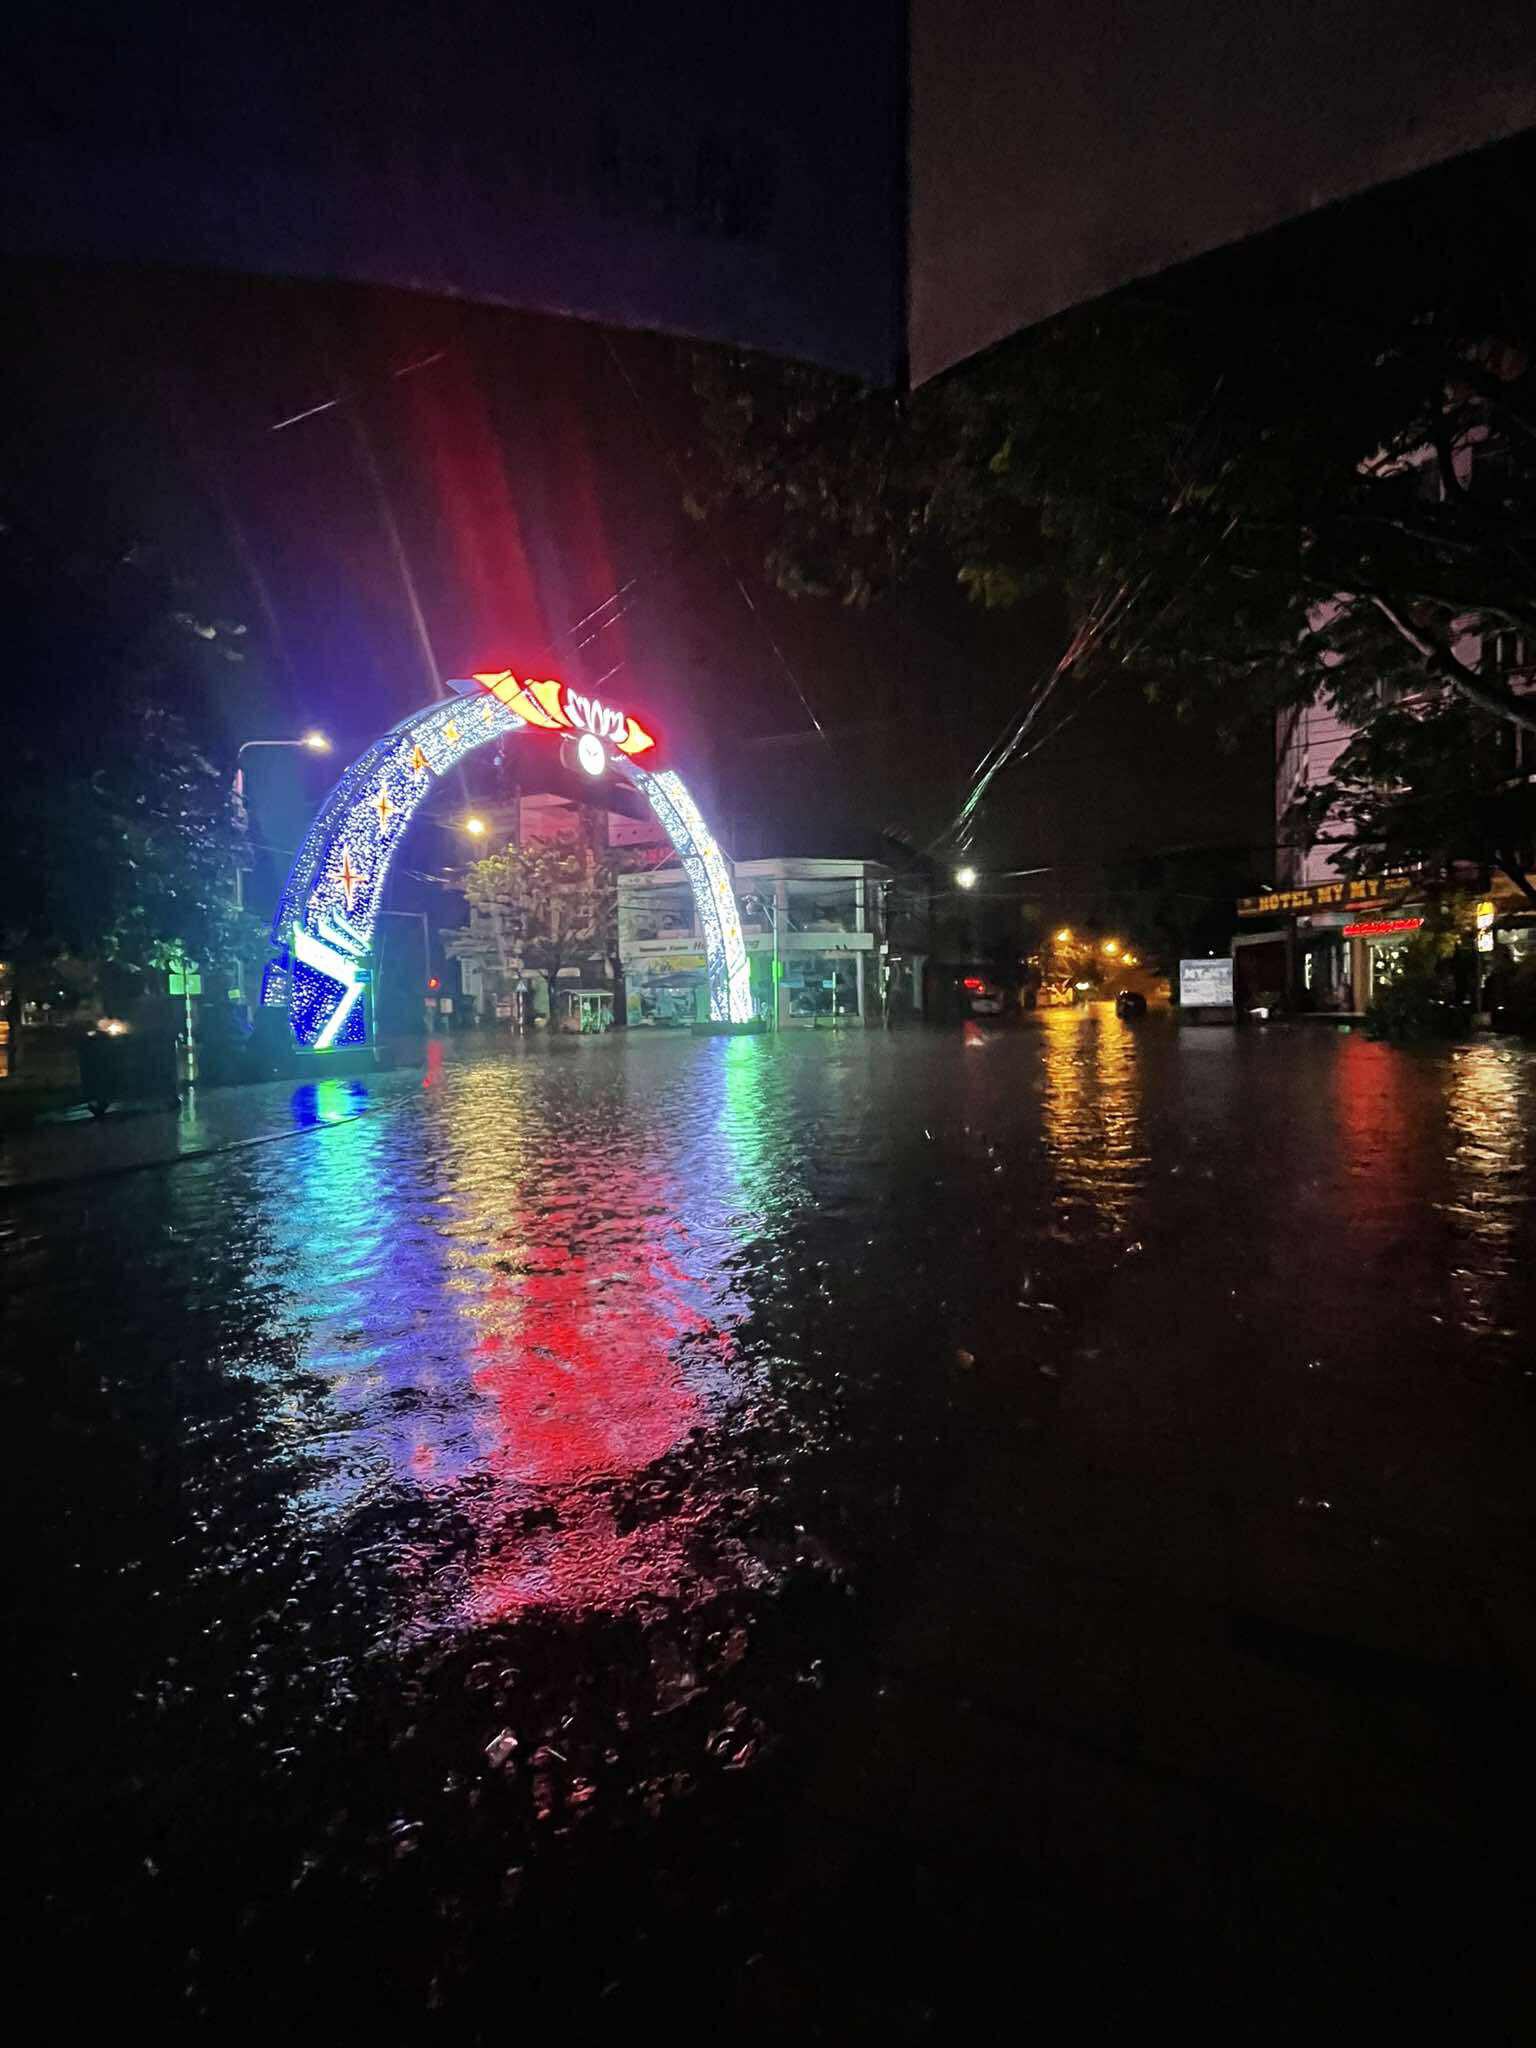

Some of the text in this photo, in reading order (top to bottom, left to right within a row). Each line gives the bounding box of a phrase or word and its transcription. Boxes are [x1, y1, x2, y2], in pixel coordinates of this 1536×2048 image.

[1258, 890, 1313, 911] HOTEL
[1315, 883, 1344, 904] MY
[1349, 878, 1379, 899] MY
